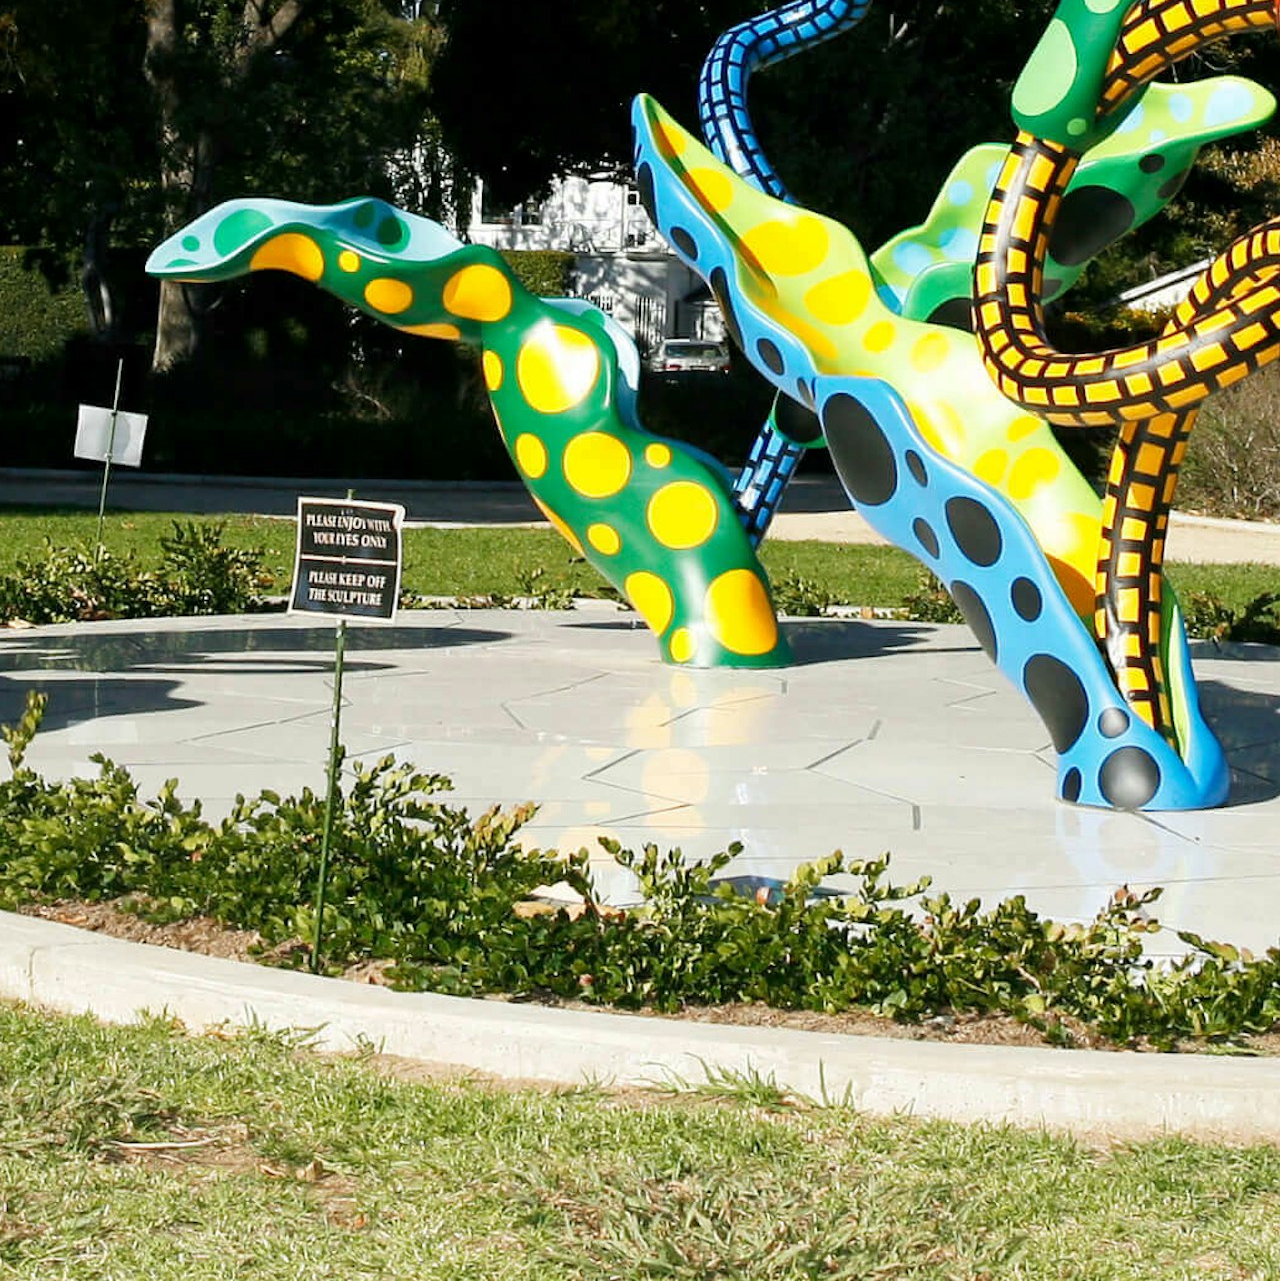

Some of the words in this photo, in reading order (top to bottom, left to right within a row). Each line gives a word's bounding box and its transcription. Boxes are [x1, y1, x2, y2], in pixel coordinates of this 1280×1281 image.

[306, 514, 337, 528] PLEASE
[337, 515, 366, 531] ENJOY
[367, 519, 390, 532] WITH
[313, 531, 335, 545] YOUR
[336, 533, 359, 546] EYES
[361, 534, 387, 549] ONLY
[309, 571, 337, 585] PLEASE
[339, 573, 366, 586] KEEP
[367, 575, 386, 589] OFF
[309, 588, 326, 601] THE
[327, 589, 383, 606] SCULPTURE
